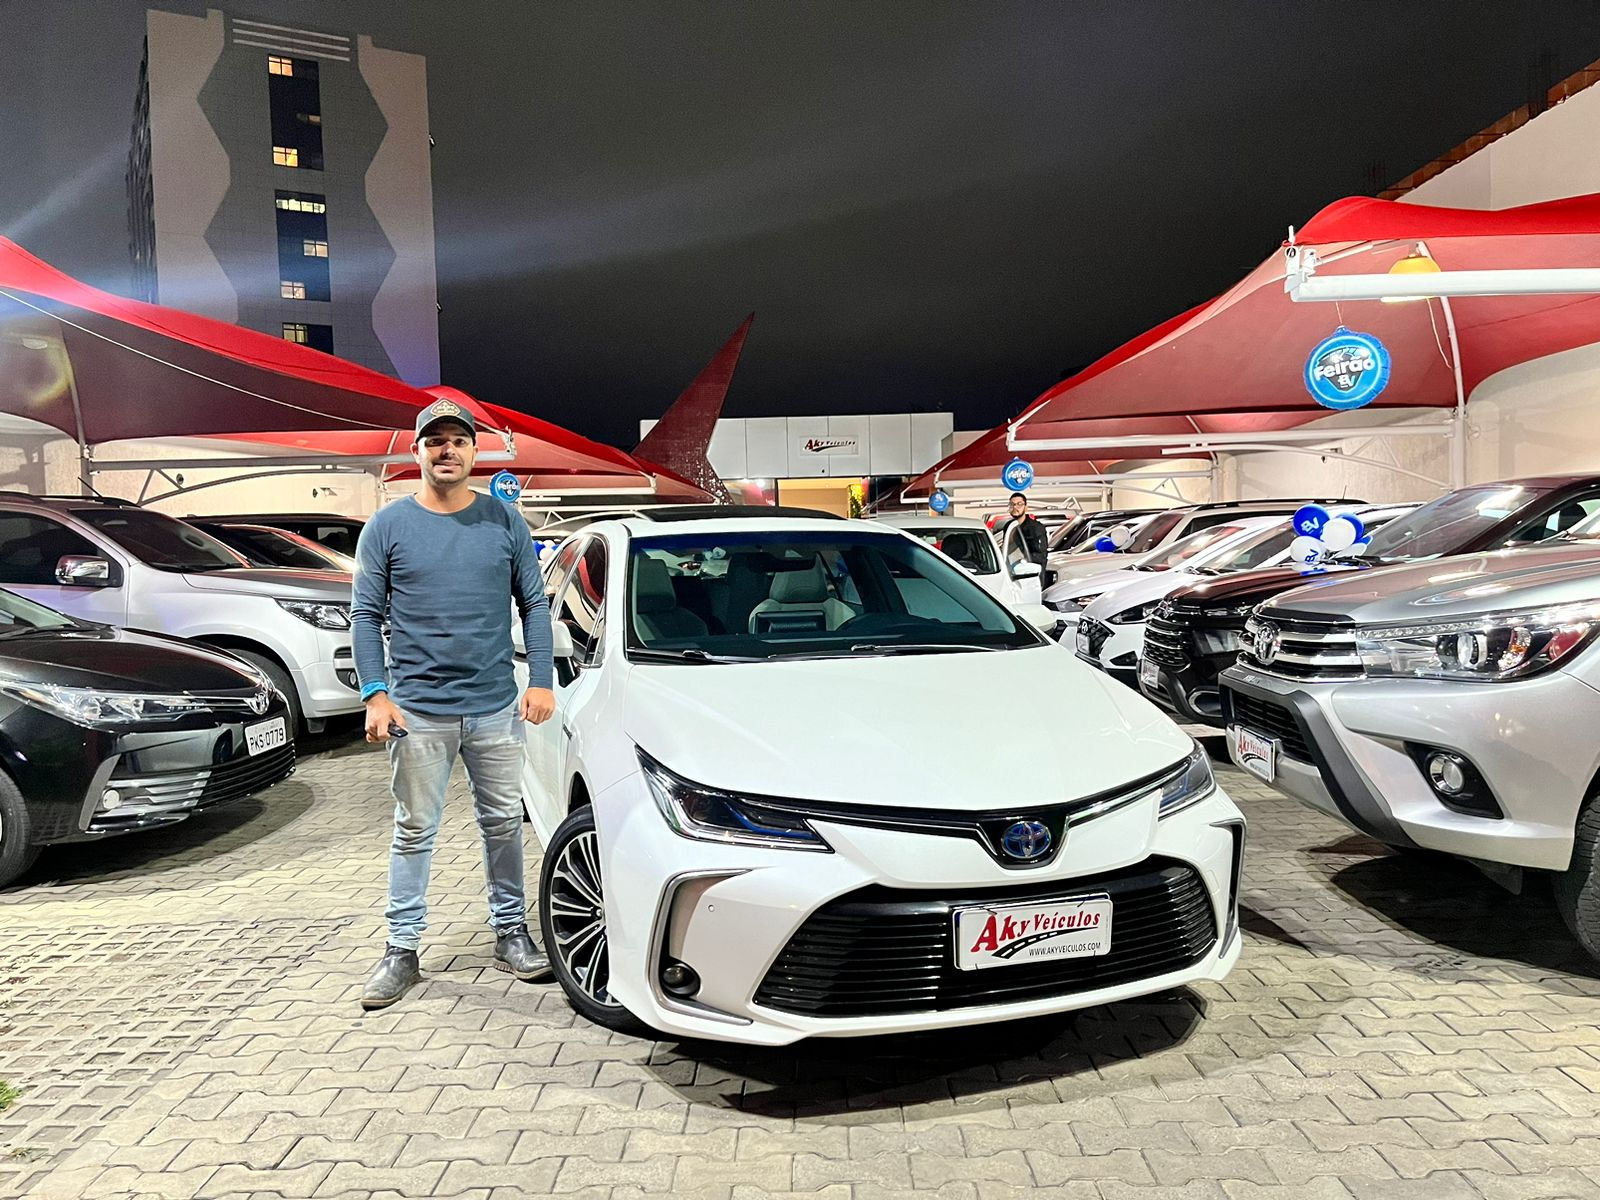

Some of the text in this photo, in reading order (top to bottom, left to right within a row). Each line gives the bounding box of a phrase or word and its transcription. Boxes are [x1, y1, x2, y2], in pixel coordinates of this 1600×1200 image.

[1313, 356, 1376, 381] Feirão
[804, 439, 825, 450] Aky
[1301, 517, 1320, 533] BV
[970, 910, 1101, 952] Aky Veículos
[1029, 942, 1101, 956] WWW.AKYVEICULOS.COM
